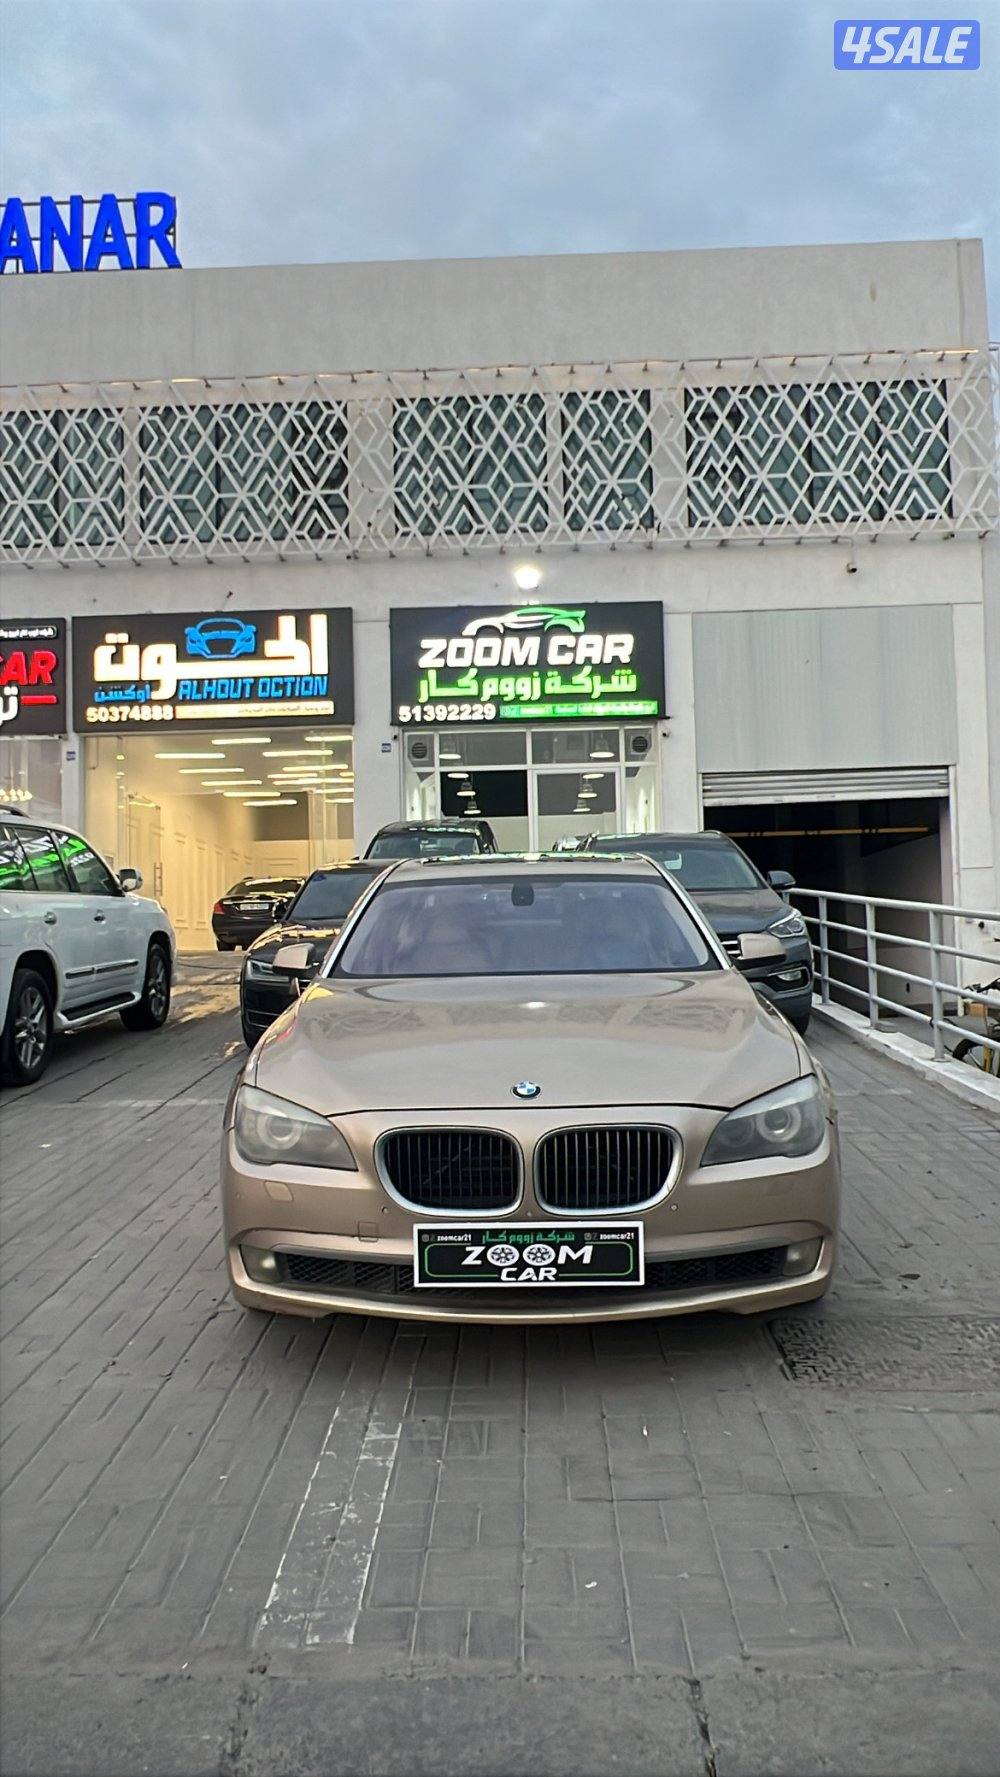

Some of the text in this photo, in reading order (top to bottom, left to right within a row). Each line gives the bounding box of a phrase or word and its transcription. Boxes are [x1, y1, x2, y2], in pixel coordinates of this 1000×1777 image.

[0, 192, 182, 275] ANAR
[93, 613, 329, 701] الحوت
[418, 633, 634, 669] ZOOM CAR
[0, 650, 57, 686] AR
[177, 674, 329, 701] ALHOUT OCTION
[418, 665, 637, 704] شركة زووم كار
[398, 702, 497, 722] 51392229
[437, 1233, 472, 1243] zoomcar21
[482, 1230, 508, 1244] كار
[536, 1230, 575, 1243] شركة
[599, 1232, 635, 1241] zoomcar21
[461, 1243, 593, 1267] ZOOM
[500, 1267, 557, 1282] CAR
